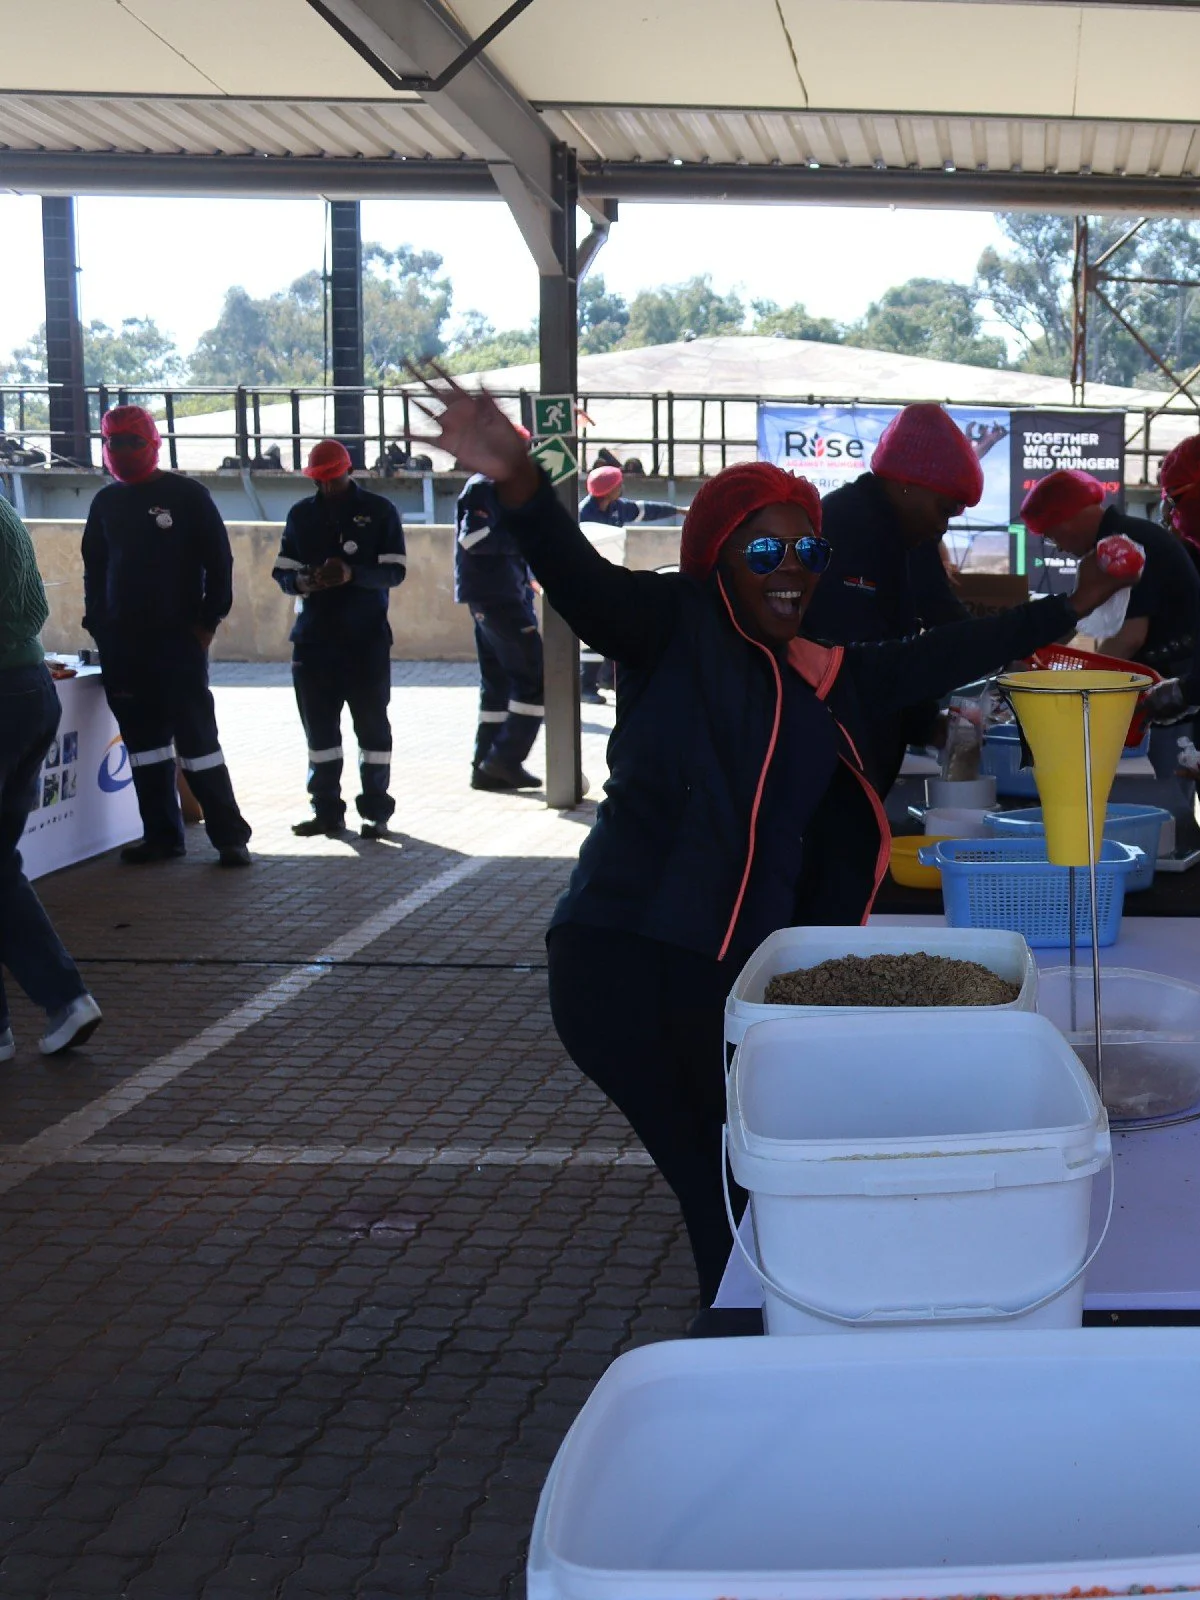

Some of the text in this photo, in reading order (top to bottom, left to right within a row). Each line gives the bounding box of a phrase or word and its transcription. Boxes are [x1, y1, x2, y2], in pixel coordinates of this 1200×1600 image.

[1023, 432, 1099, 445] TOGETHER
[1023, 445, 1082, 457] WE CAN
[1023, 457, 1120, 471] END HUNGER!
